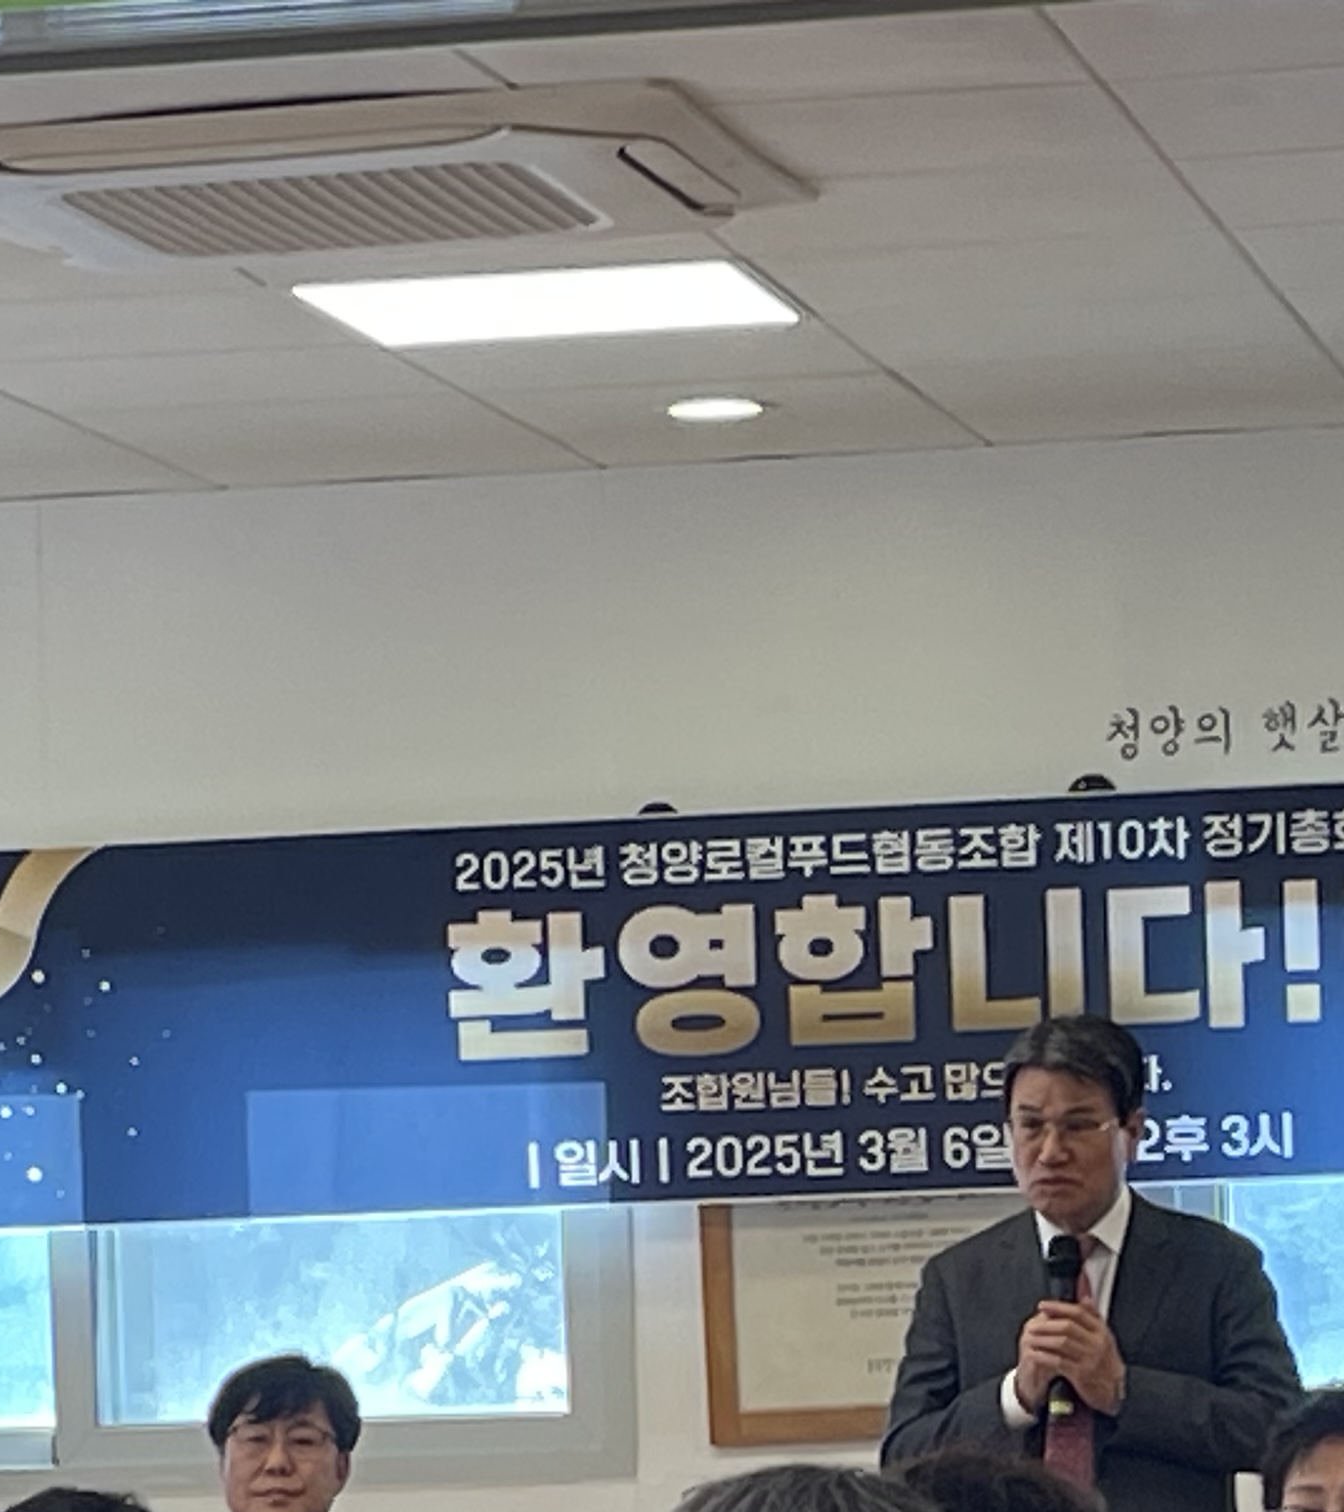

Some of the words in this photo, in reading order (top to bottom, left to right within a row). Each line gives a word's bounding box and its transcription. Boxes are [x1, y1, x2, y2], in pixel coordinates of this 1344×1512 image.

[1106, 704, 1231, 760] 청양의
[455, 843, 606, 892] 2025년
[618, 822, 1042, 886] 청양로컬푸드협동조합
[1055, 815, 1190, 864] 제10차
[660, 1067, 851, 1113] 조합원님들!
[862, 1064, 936, 1104] 수고
[556, 1137, 642, 1187] 일시
[686, 1129, 846, 1179] 2025년
[858, 1126, 929, 1174] 3월
[943, 1122, 1013, 1171] 6일
[1221, 1110, 1294, 1159] 3시
